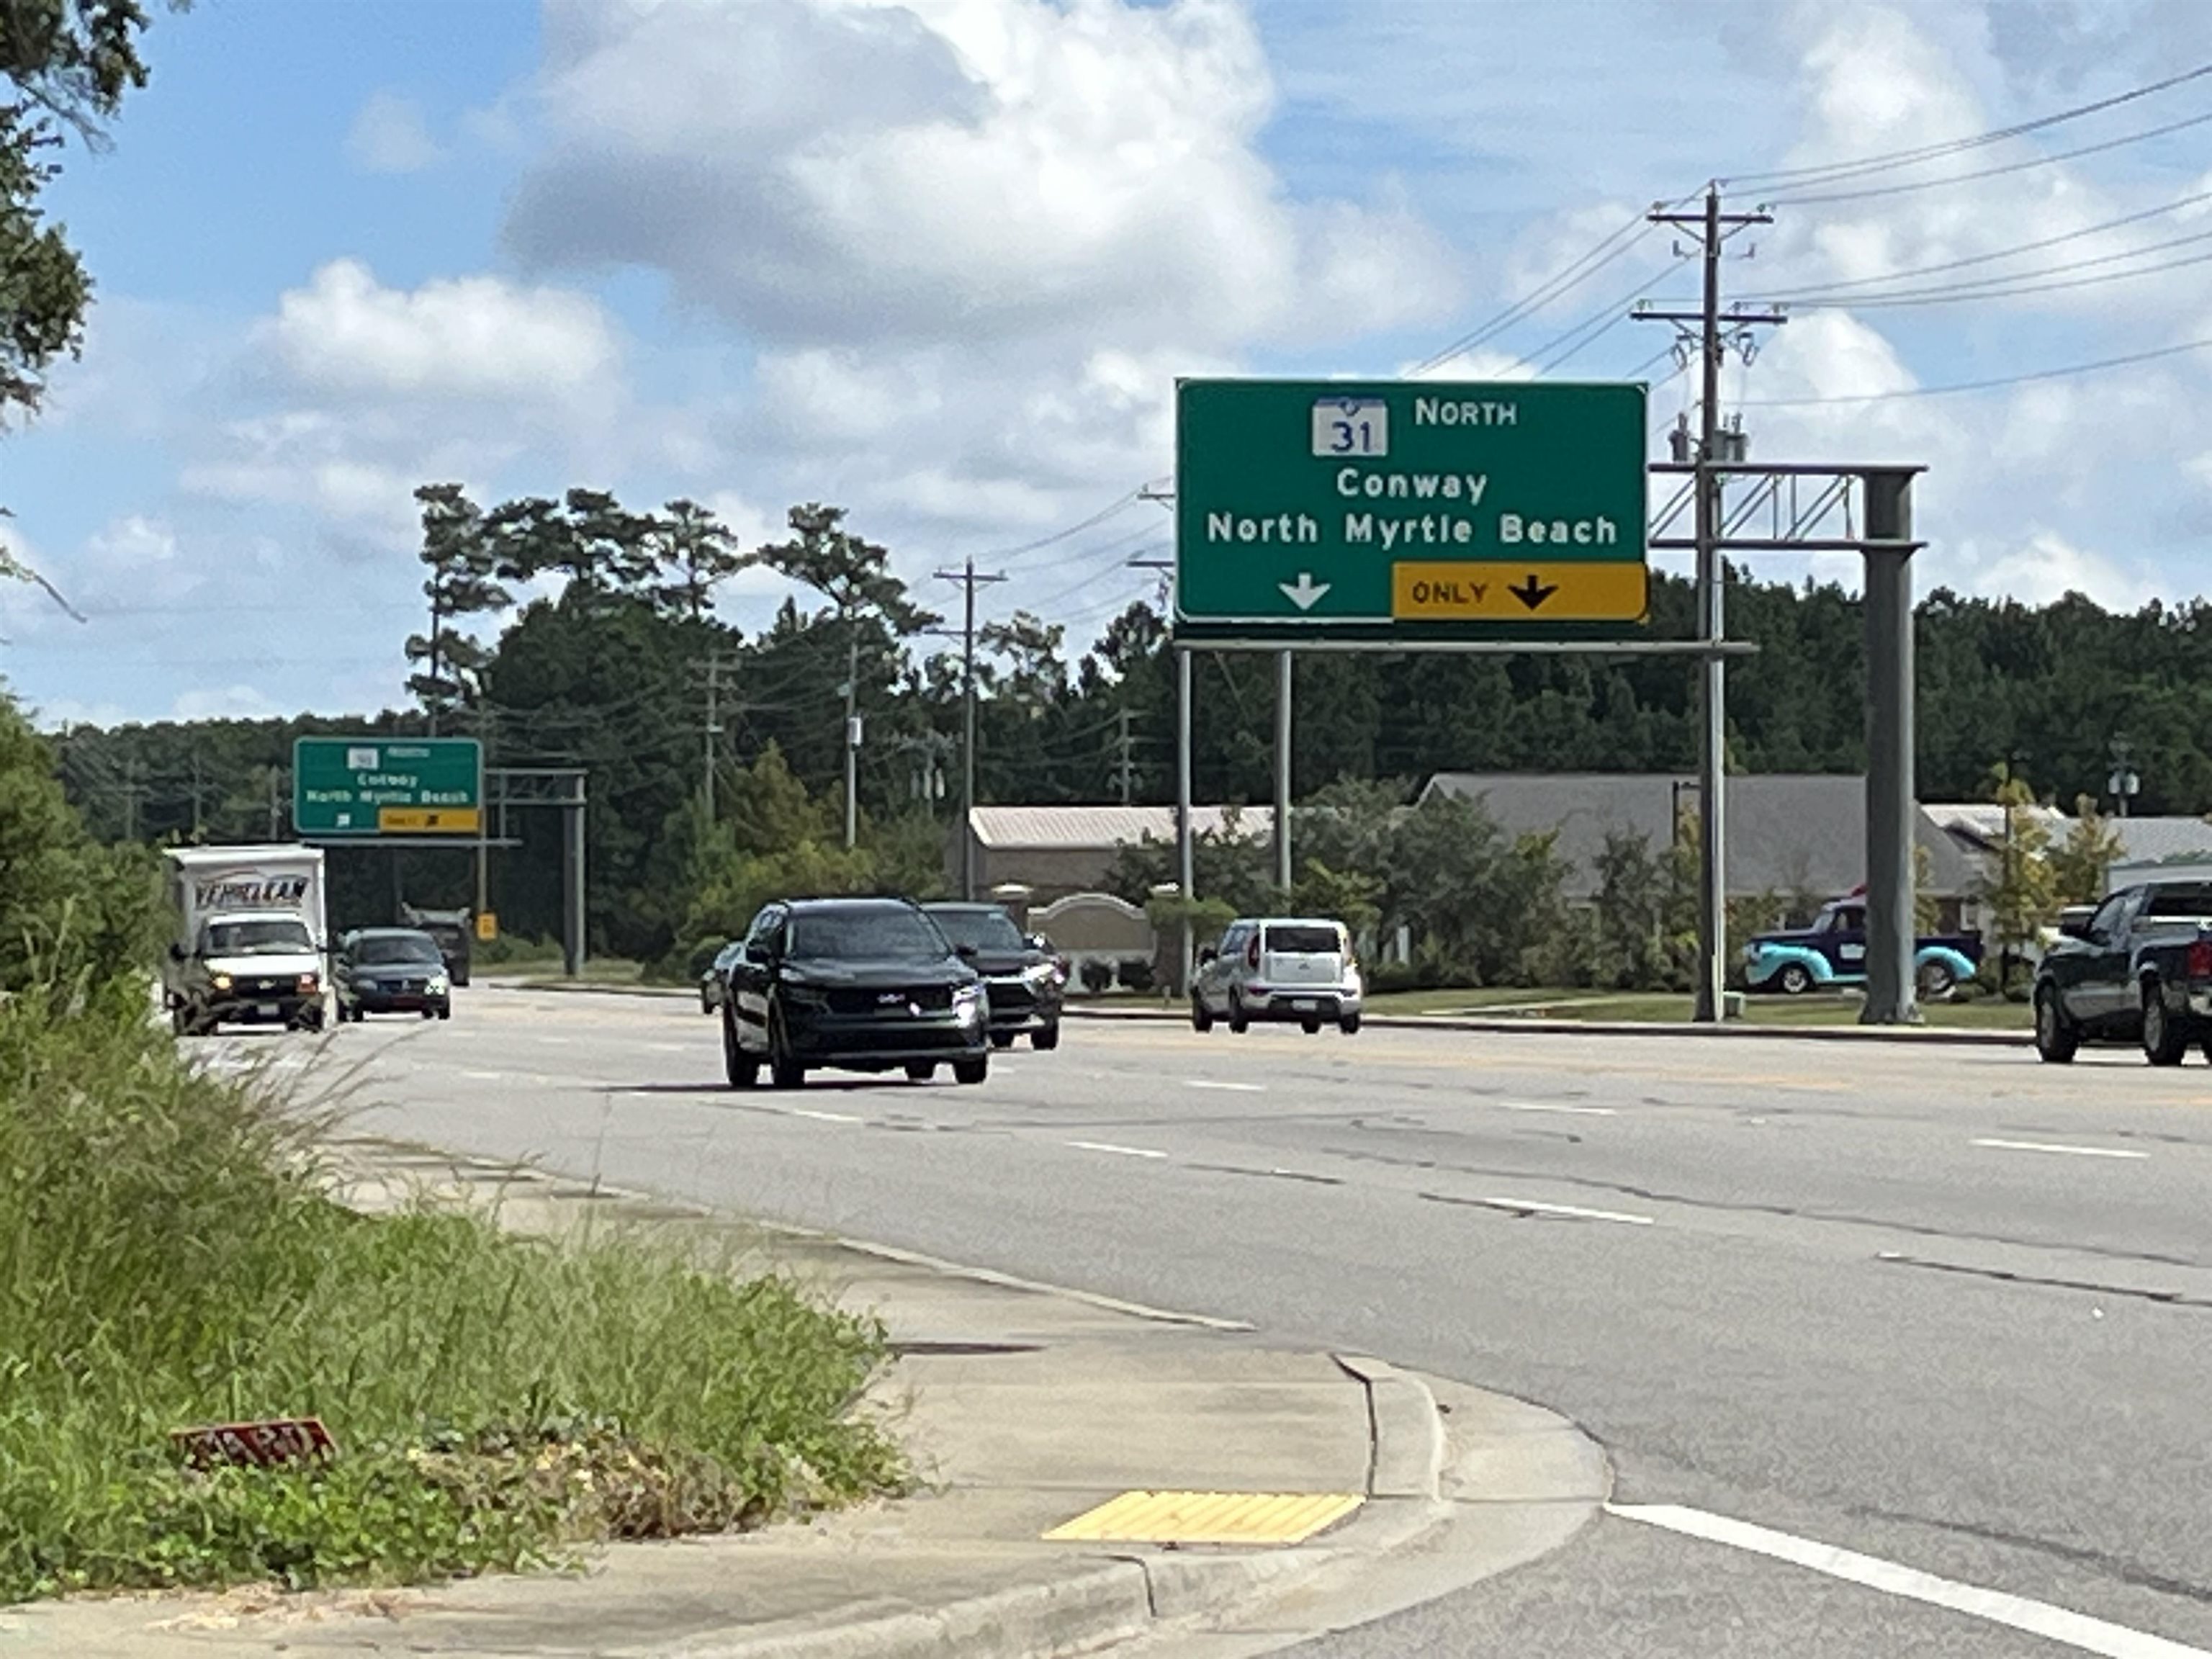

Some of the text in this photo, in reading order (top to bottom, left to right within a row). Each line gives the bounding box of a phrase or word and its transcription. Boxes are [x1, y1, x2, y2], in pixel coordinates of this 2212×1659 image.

[1331, 397, 1517, 452] 31 NORTH
[1337, 468, 1488, 505] Conway
[1208, 512, 1617, 550] North Myrtle Beach
[1412, 581, 1488, 604] ONLY
